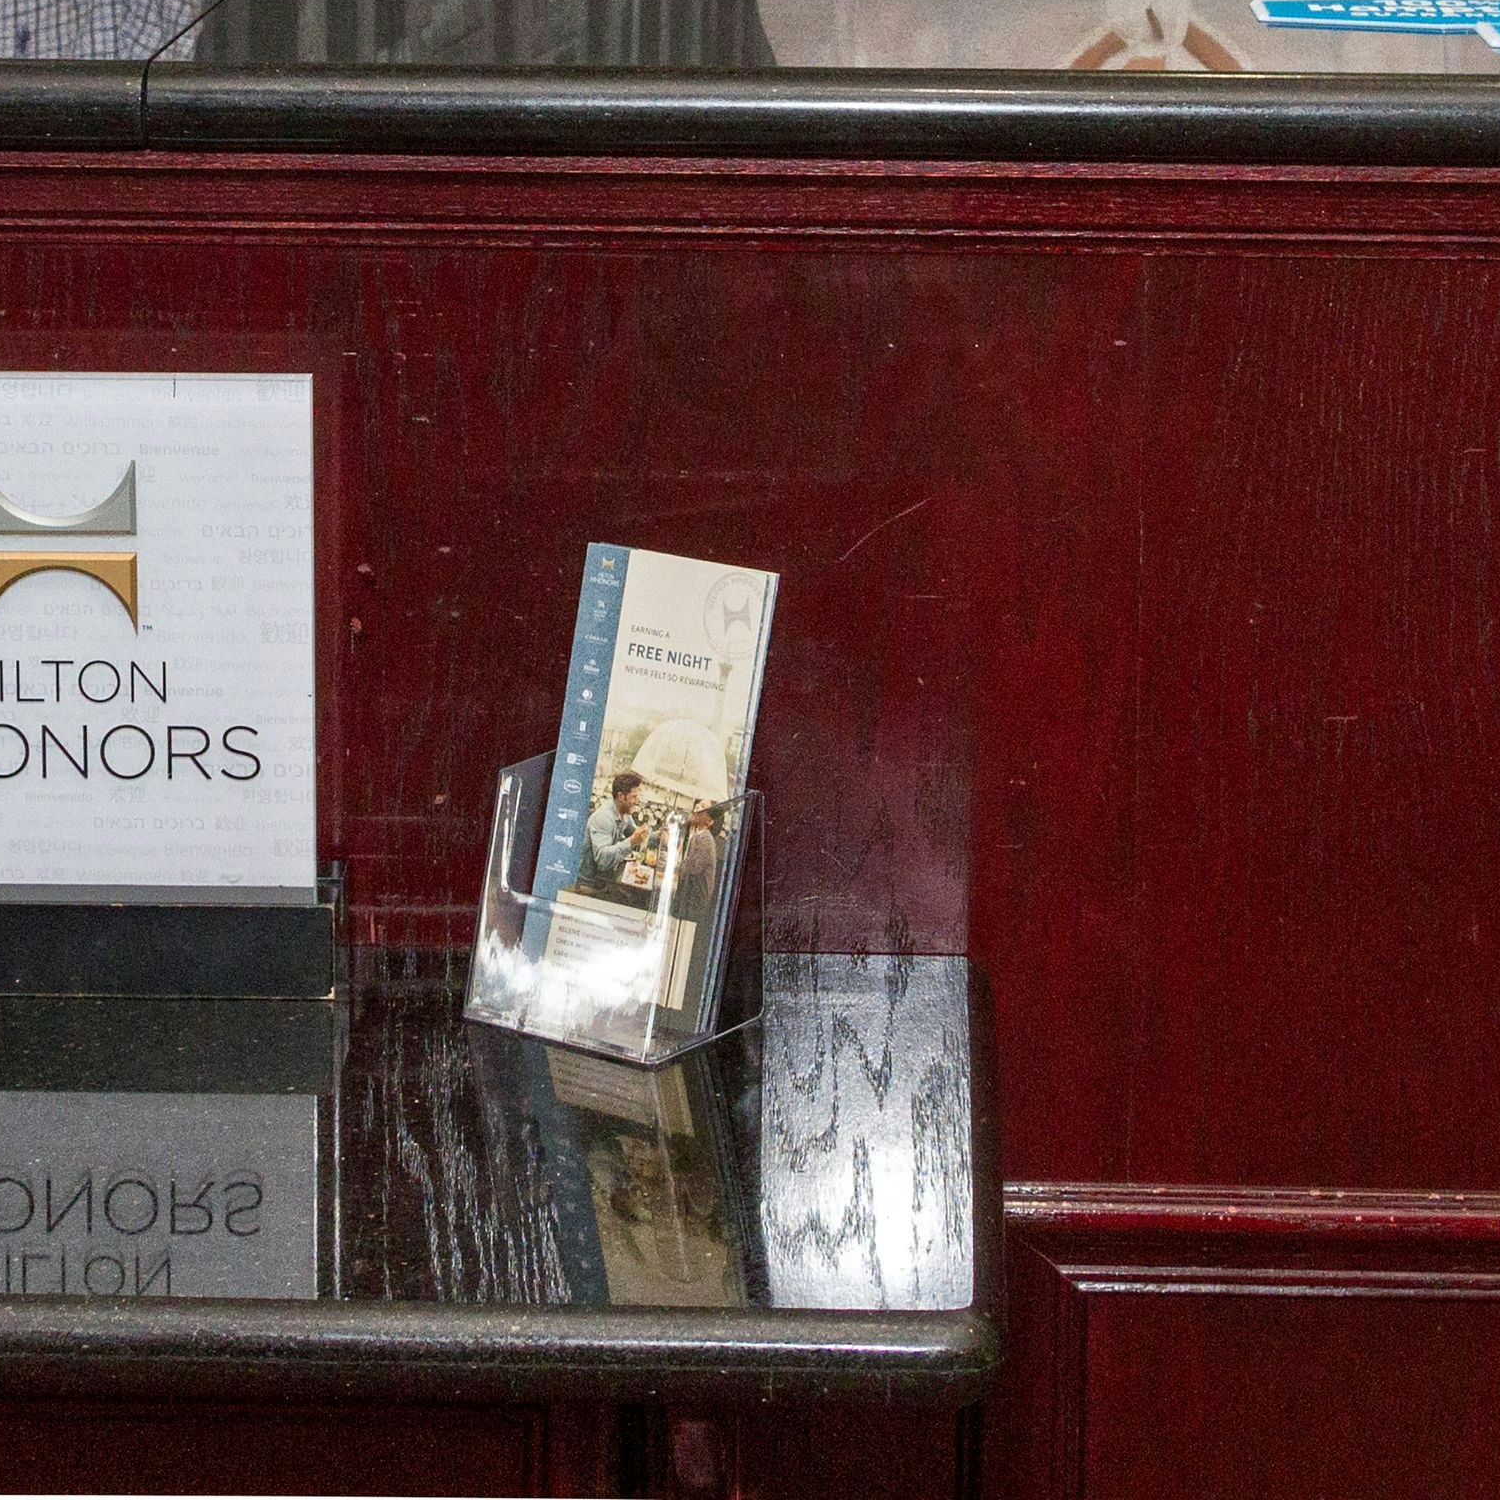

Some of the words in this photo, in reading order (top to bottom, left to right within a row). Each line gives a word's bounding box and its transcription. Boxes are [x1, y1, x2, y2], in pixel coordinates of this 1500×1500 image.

[631, 624, 664, 638] EARNING
[628, 642, 663, 662] FREE
[666, 650, 713, 671] NIGHT
[624, 664, 649, 677] NEVER
[650, 669, 667, 681] FELT
[668, 672, 678, 683] SO
